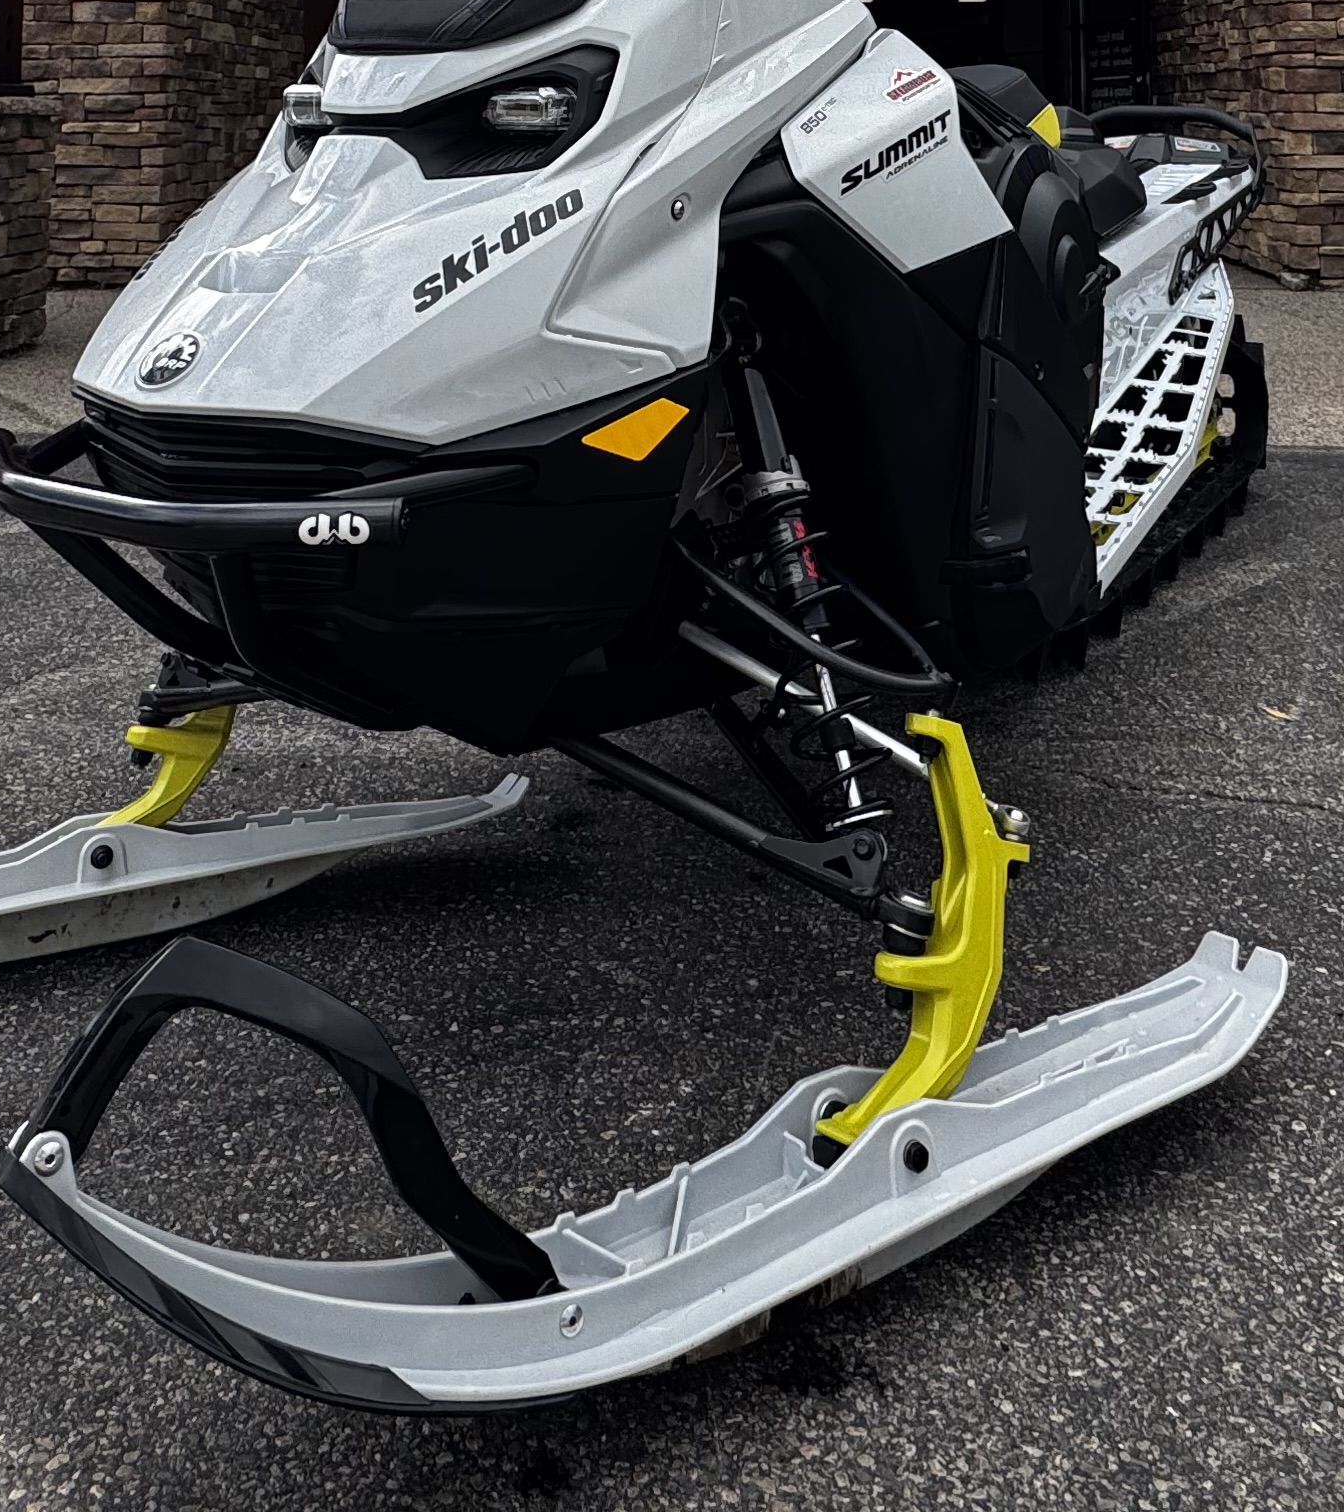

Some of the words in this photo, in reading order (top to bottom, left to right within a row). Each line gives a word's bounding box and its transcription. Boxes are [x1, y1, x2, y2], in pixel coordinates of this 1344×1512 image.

[800, 109, 828, 135] 850
[840, 109, 951, 196] SUMMIT
[886, 135, 949, 180] ADRENALINE
[413, 187, 584, 313] ski-doo
